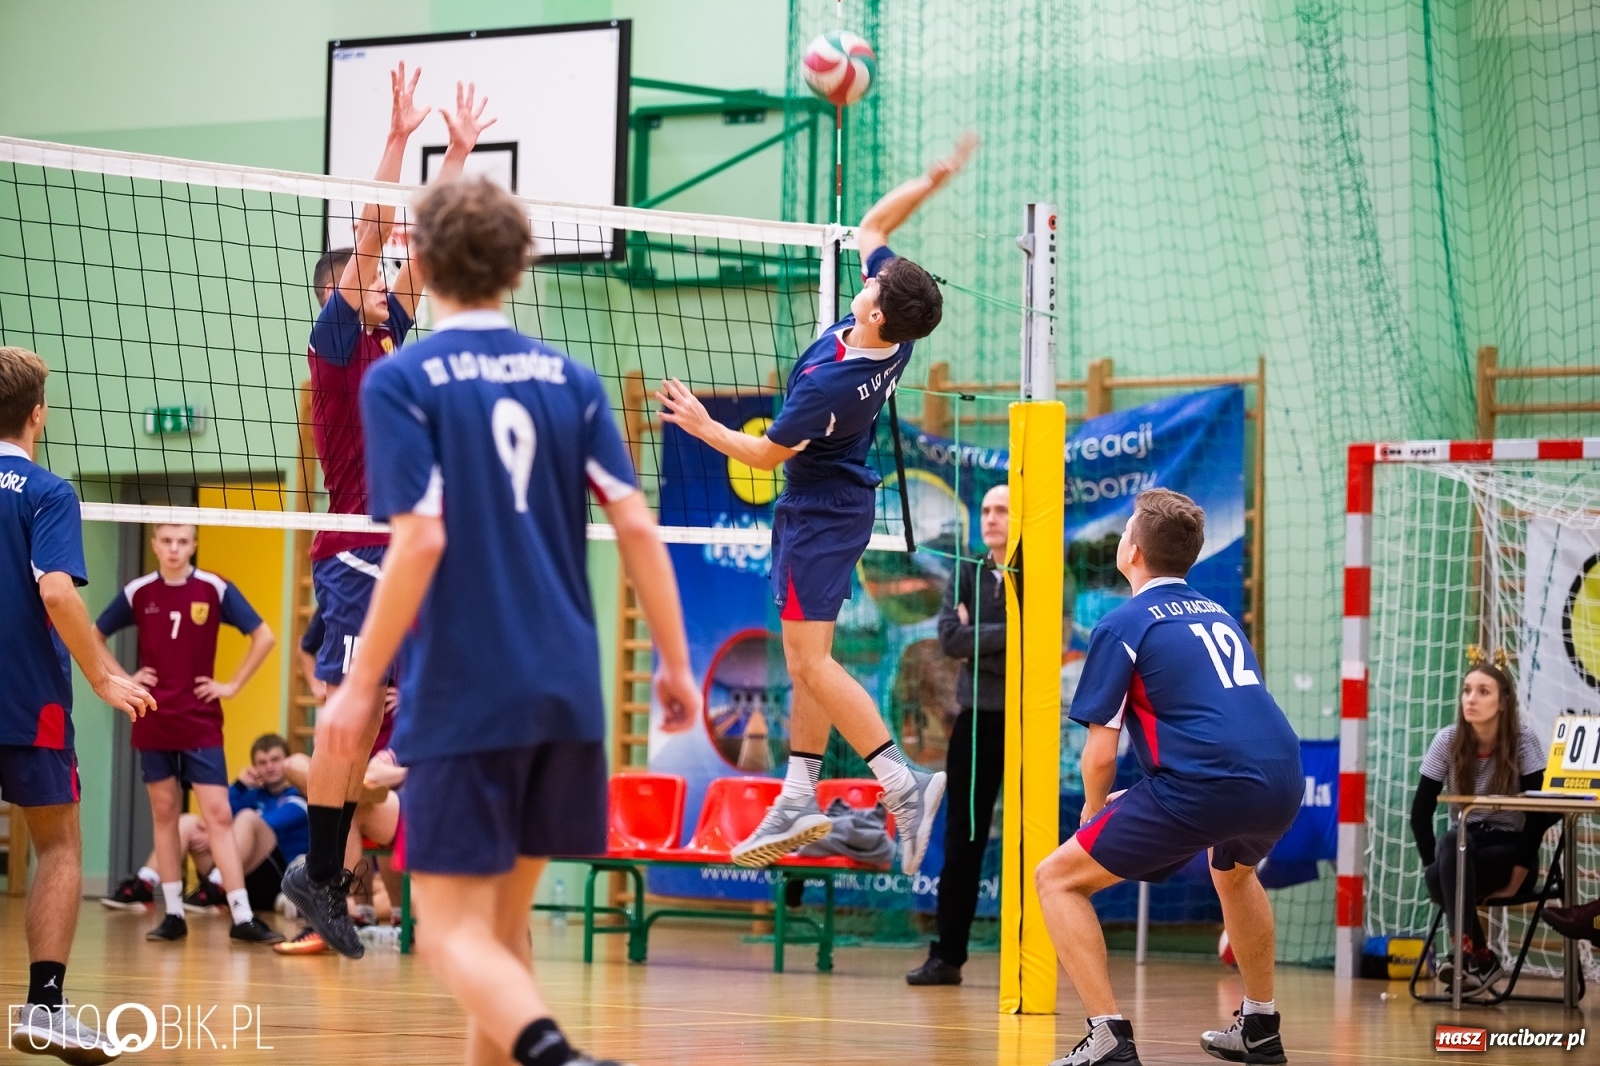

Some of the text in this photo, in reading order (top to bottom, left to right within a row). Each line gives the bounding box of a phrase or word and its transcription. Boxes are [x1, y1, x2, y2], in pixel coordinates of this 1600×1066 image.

[857, 383, 870, 401] II
[871, 373, 882, 392] LO
[491, 397, 538, 513] 9
[1064, 422, 1154, 464] kreacji
[169, 610, 182, 640] 7
[1148, 605, 1166, 620] II
[1164, 601, 1184, 616] LO
[1188, 621, 1260, 689] 12
